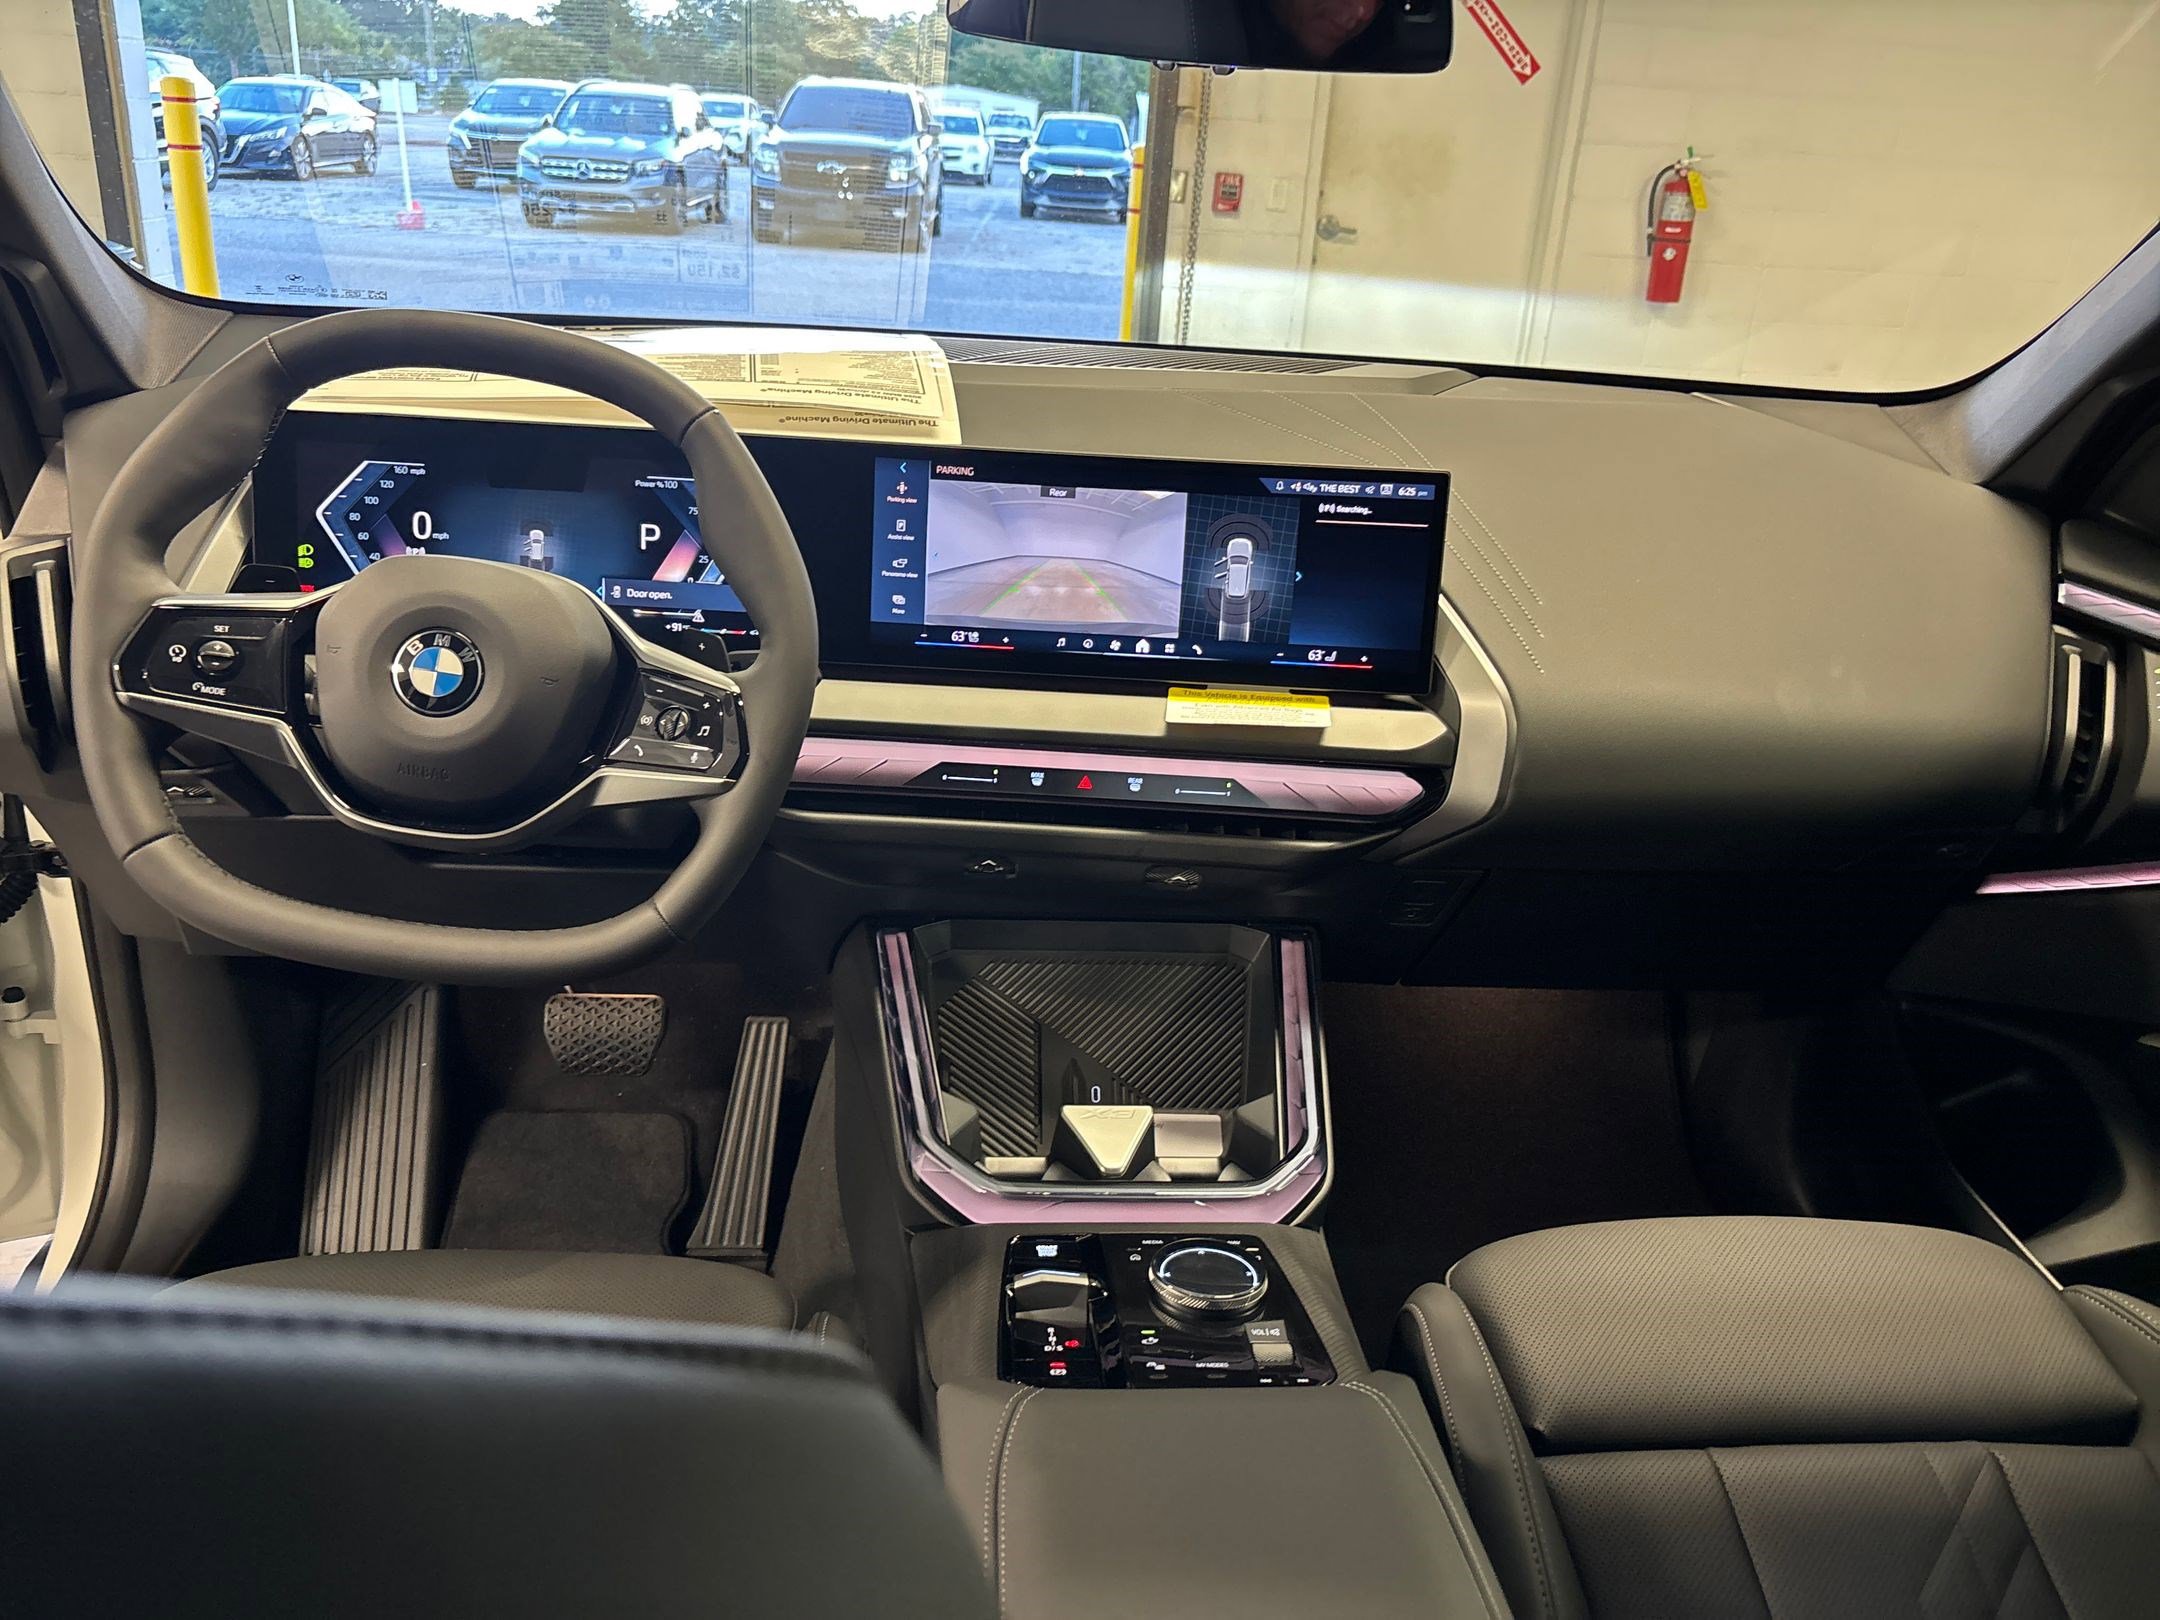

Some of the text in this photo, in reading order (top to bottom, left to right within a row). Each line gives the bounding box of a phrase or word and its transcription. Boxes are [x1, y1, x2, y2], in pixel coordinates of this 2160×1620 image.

[815, 389, 852, 398] Driving
[855, 392, 899, 403] Ultimate
[832, 415, 870, 425] Driving
[872, 418, 916, 427] Ultimate
[918, 419, 939, 427] The
[393, 466, 408, 475] 160
[936, 465, 975, 477] PARKING
[379, 480, 395, 489] 120
[634, 479, 656, 488] Power
[1049, 488, 1067, 497] Rear
[1319, 483, 1360, 494] THE BEST
[363, 496, 380, 505] 100
[688, 507, 699, 515] 75
[348, 512, 361, 521] 80
[411, 510, 433, 540] 0
[357, 532, 369, 541] 60
[432, 532, 450, 540] mph
[640, 523, 661, 551] P
[368, 552, 381, 561] 40
[698, 555, 710, 564] 25
[626, 588, 648, 599] Door
[213, 625, 230, 633] SET
[406, 633, 476, 663] BMW
[200, 685, 227, 696] MODE
[397, 762, 449, 780] AIRBAG
